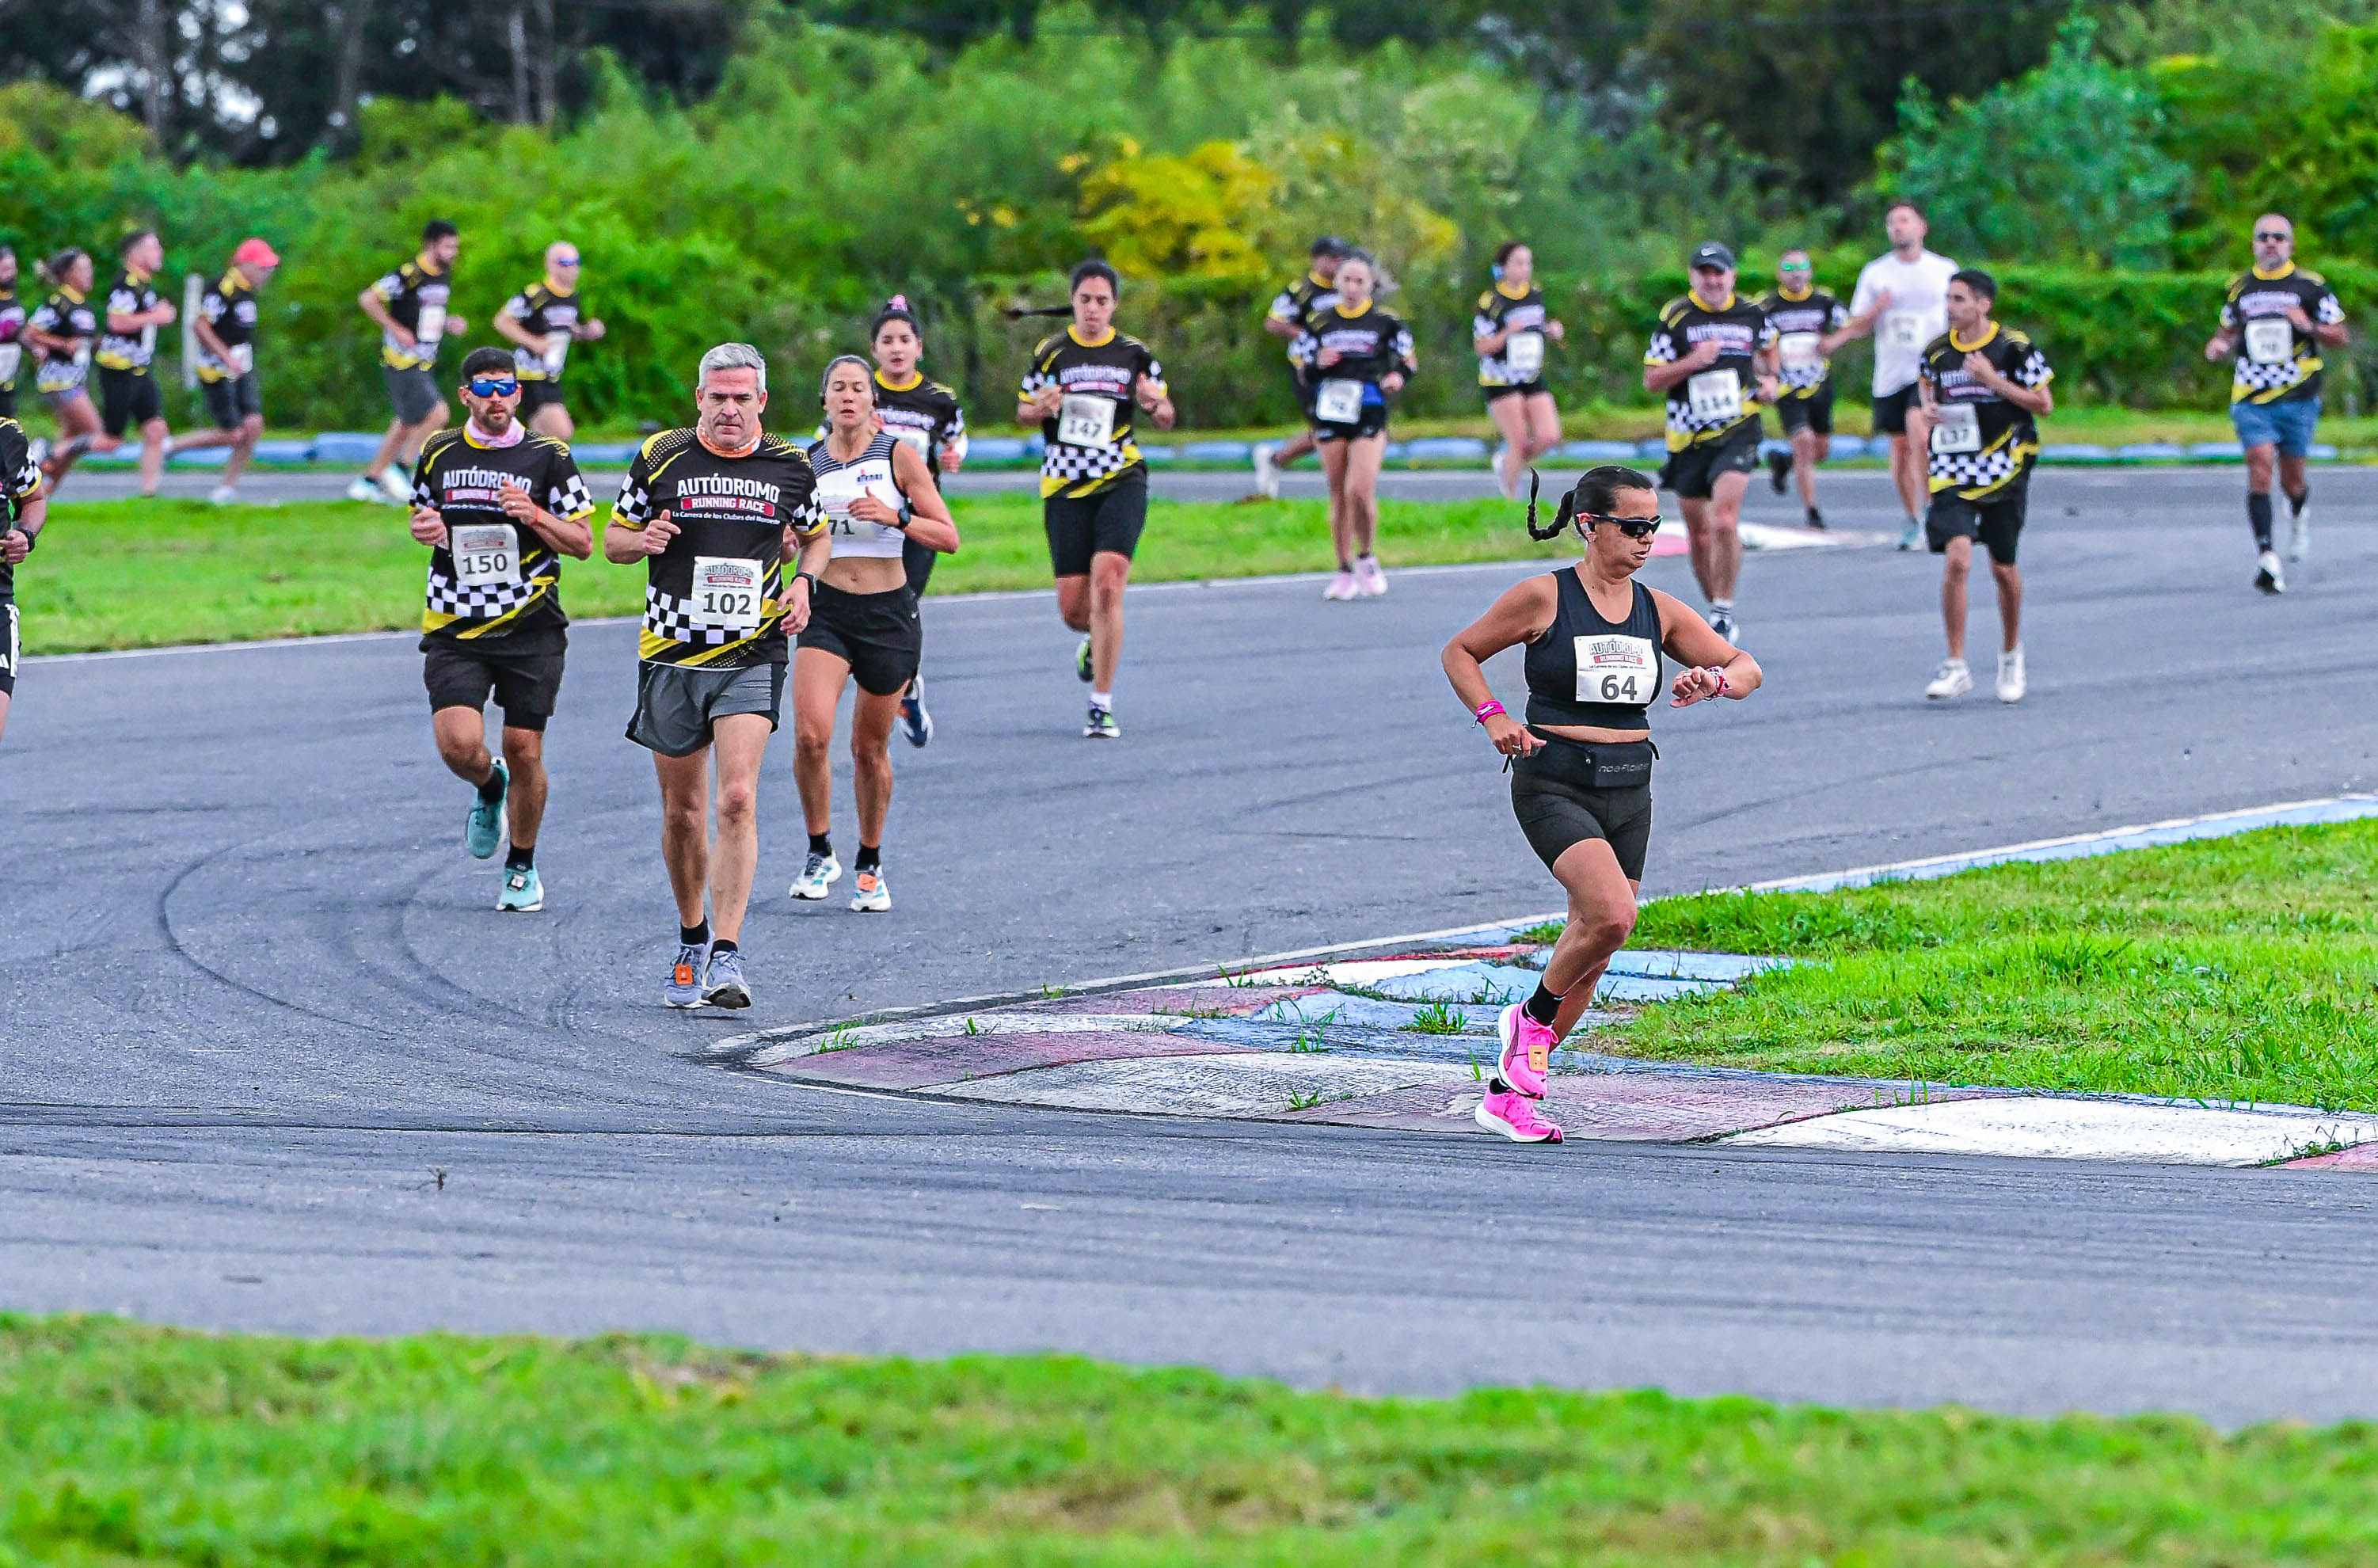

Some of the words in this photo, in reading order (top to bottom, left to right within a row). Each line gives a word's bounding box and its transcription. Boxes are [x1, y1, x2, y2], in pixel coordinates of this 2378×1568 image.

[1071, 420, 1103, 437] 147
[677, 473, 780, 503] AUTÓDROMO
[691, 497, 736, 509] RUNNING
[738, 497, 766, 513] RACE
[463, 553, 508, 575] 150
[702, 592, 751, 615] 102
[1600, 674, 1638, 701] 64
